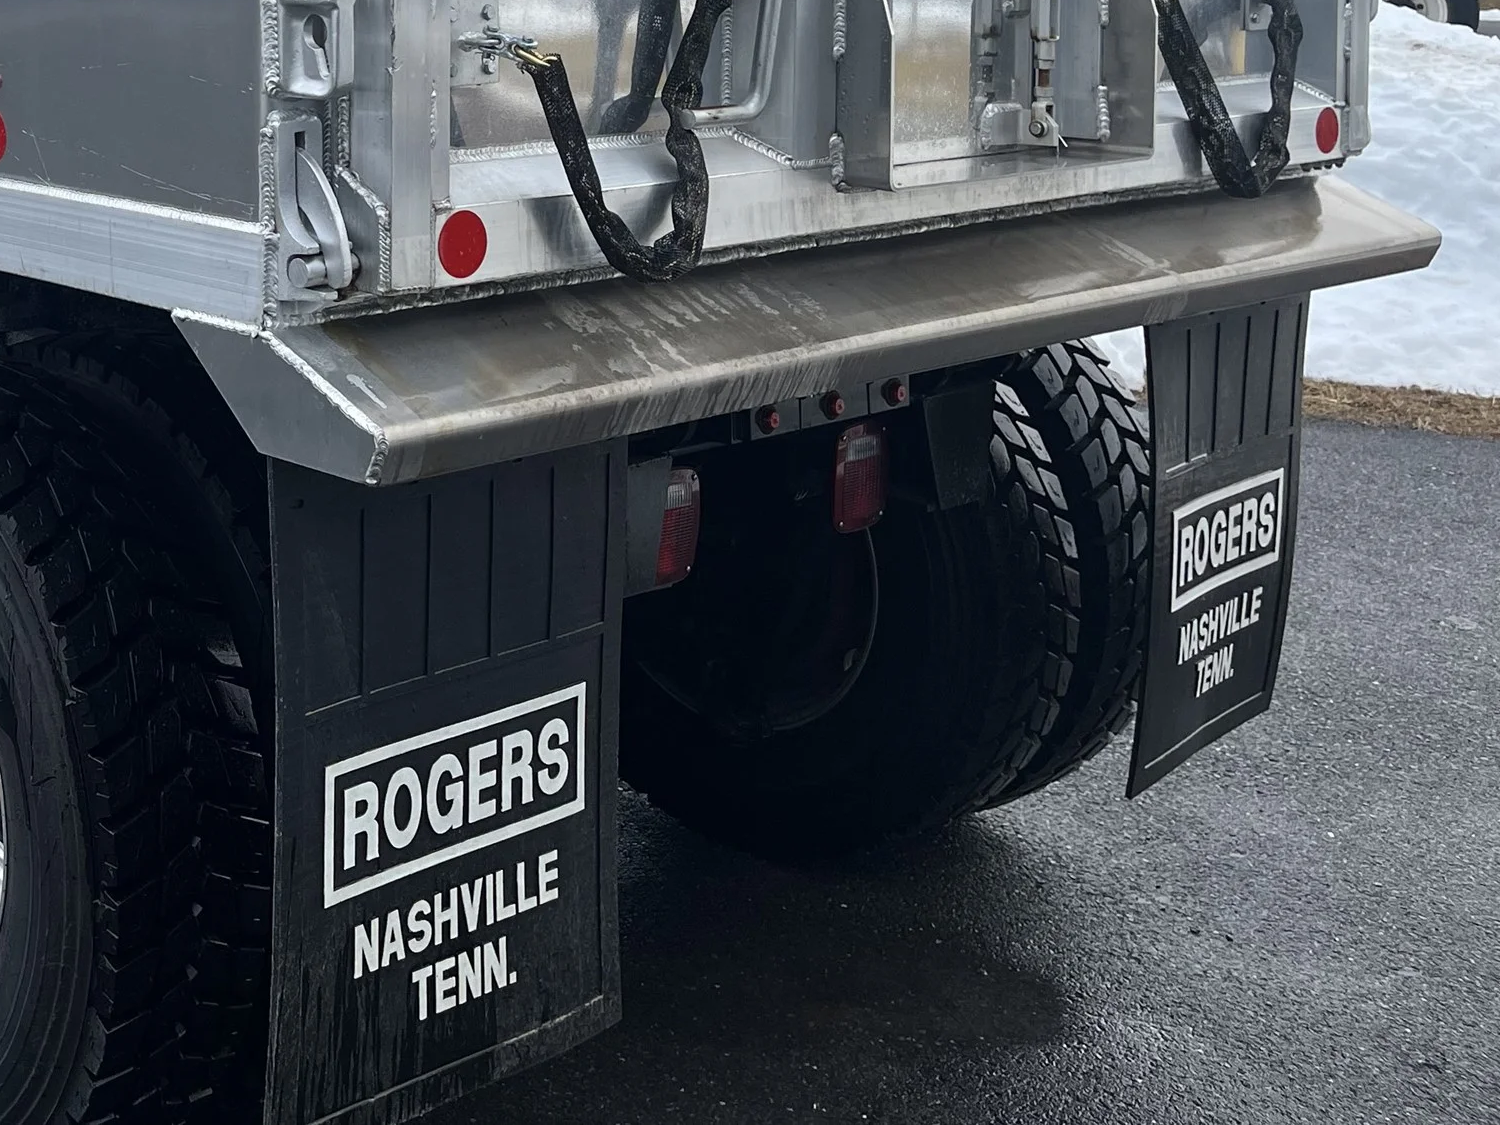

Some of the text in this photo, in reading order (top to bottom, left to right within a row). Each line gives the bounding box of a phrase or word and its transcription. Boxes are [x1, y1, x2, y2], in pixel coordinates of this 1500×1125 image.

[1179, 492, 1276, 587] ROGERS
[1177, 586, 1263, 665] NASHVILLE
[1195, 643, 1235, 698] TENN.
[343, 717, 570, 870] ROGERS
[353, 849, 559, 979] NASHVILLE
[411, 937, 518, 1021] TENN.
